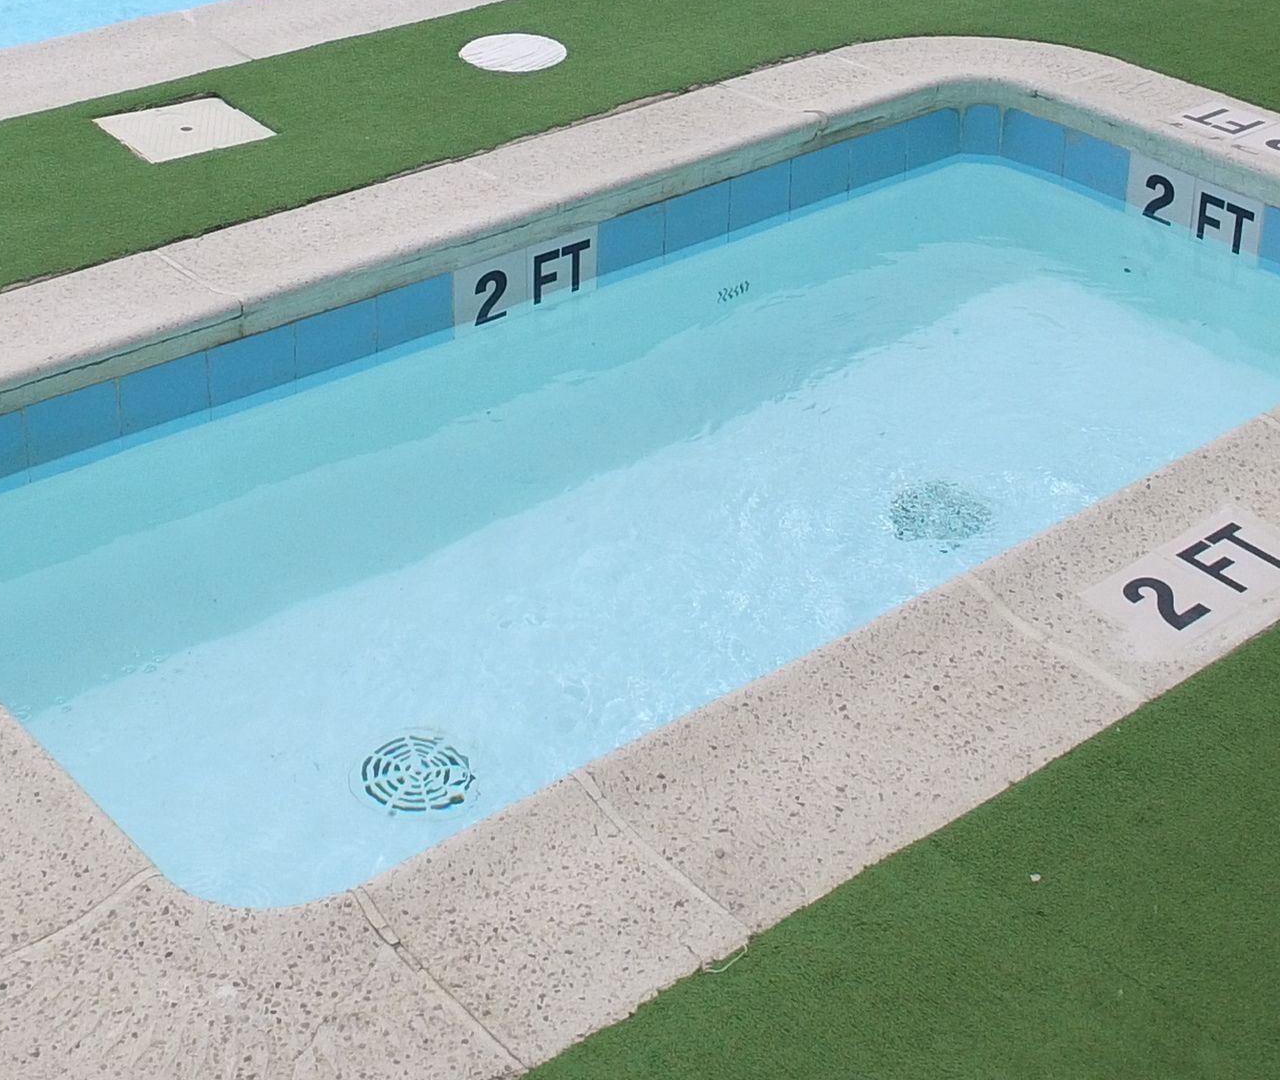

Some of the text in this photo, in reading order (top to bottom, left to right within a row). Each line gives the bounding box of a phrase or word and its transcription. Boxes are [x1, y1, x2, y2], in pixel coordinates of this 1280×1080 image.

[1182, 108, 1266, 135] FT
[1142, 174, 1255, 256] 2 FT
[474, 238, 591, 327] 2 FT
[1122, 576, 1212, 631] 2
